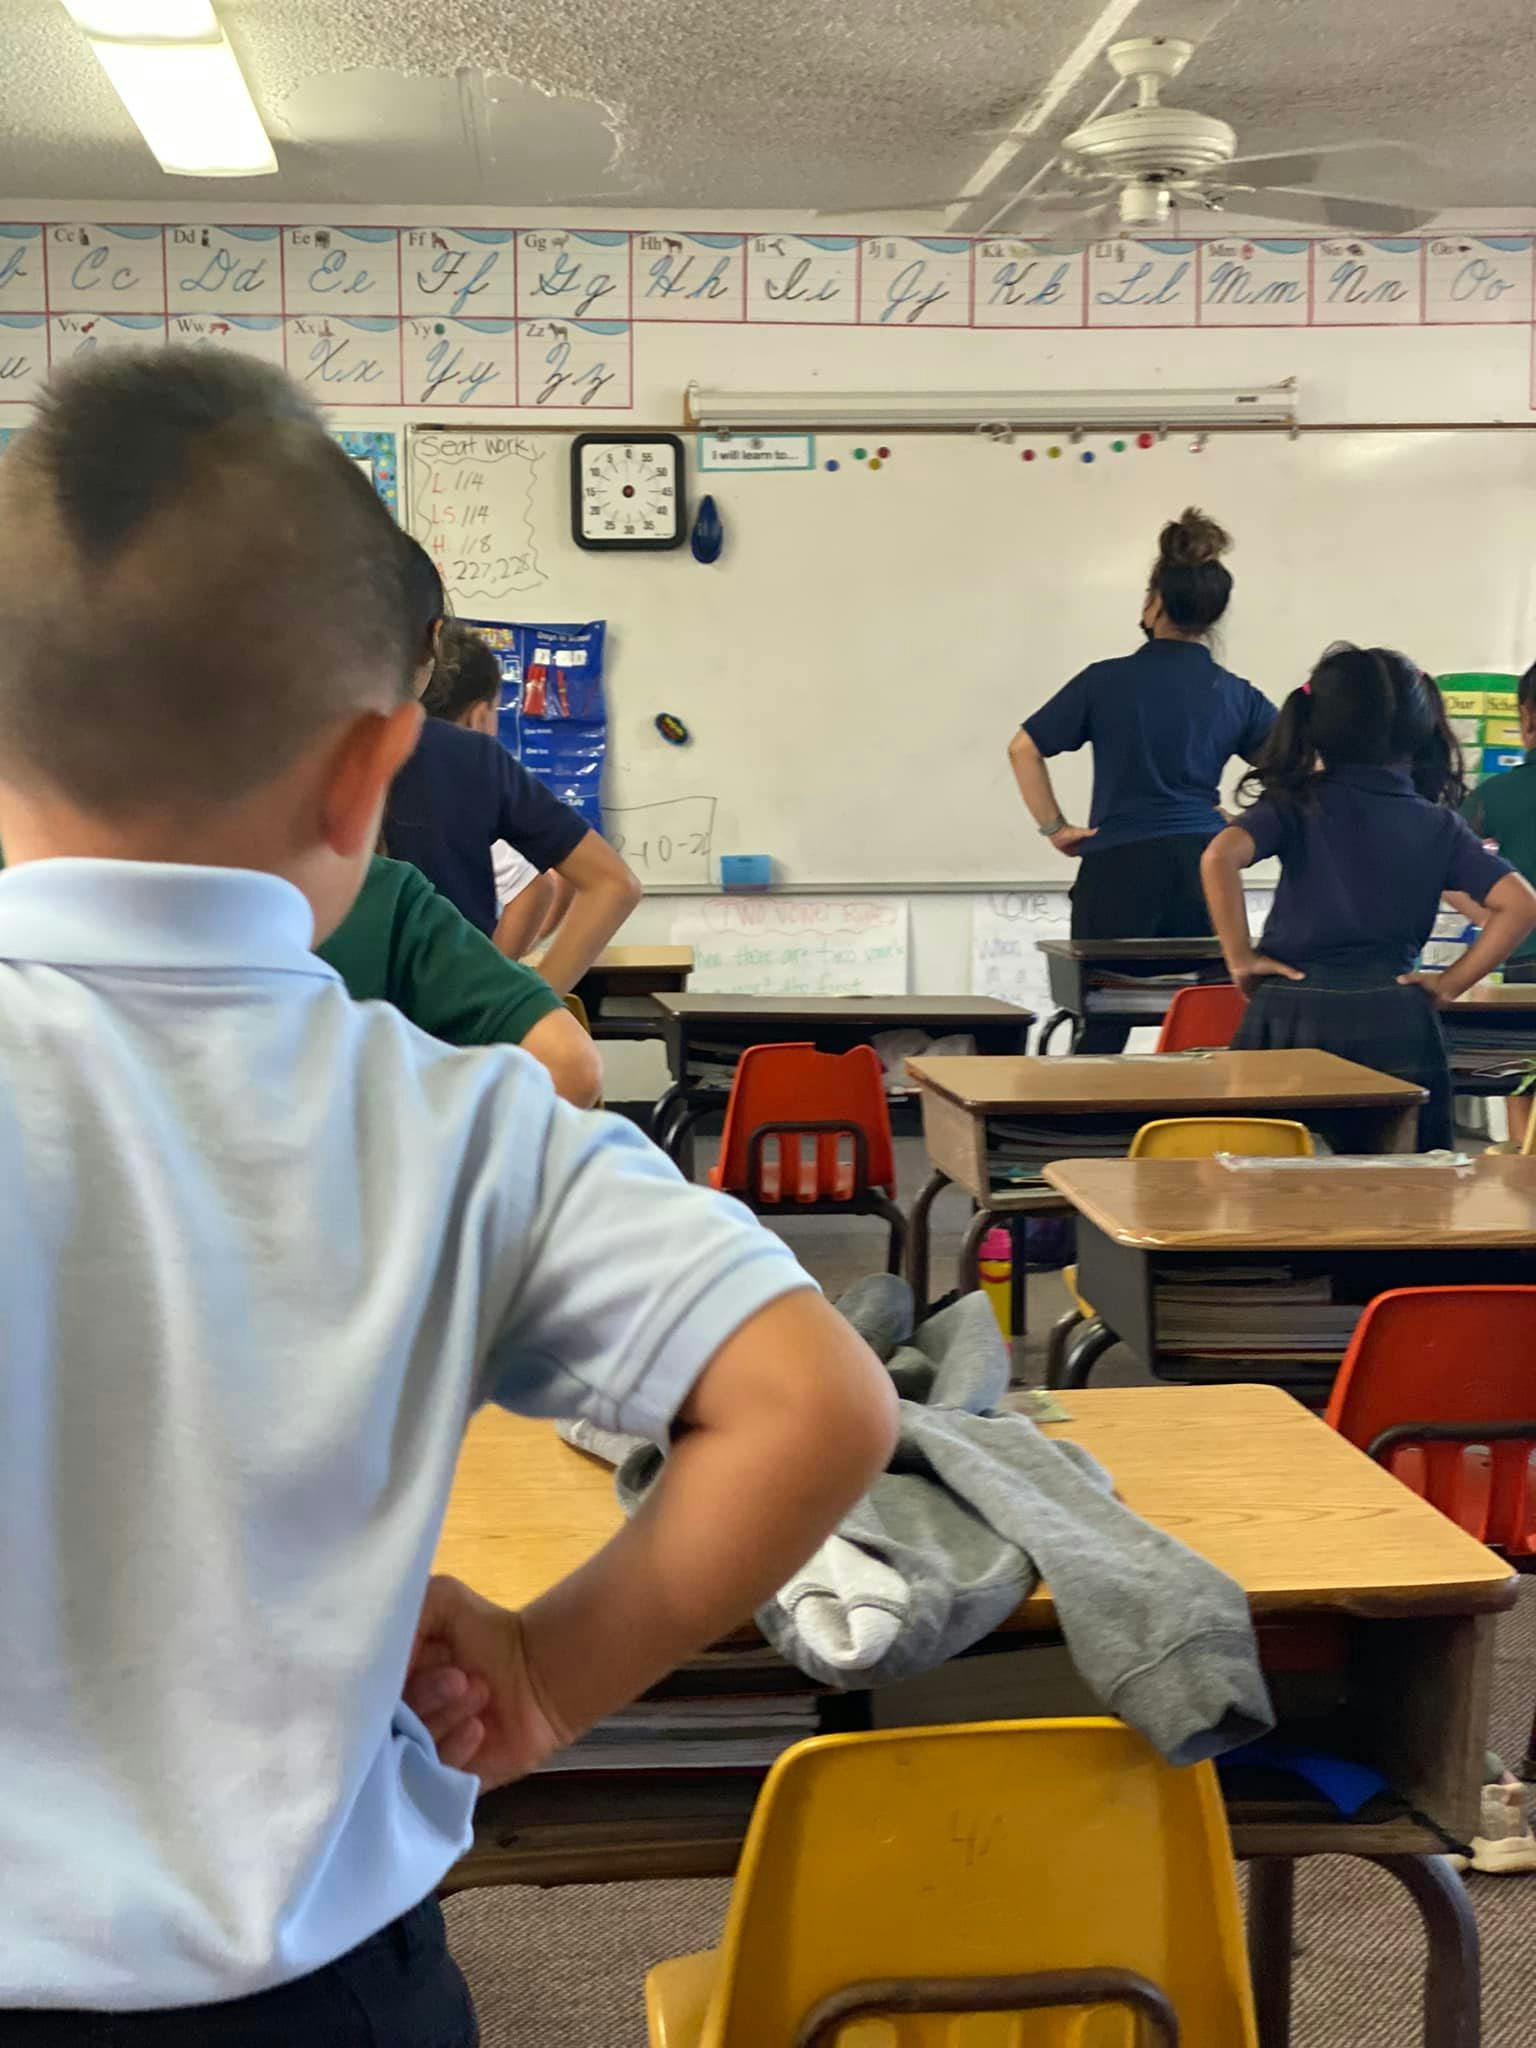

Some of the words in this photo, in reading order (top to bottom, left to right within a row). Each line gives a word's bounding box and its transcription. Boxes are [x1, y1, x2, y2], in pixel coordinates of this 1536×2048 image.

[54, 227, 76, 243] Cc
[173, 227, 196, 244] Dd
[408, 232, 425, 246] Ff
[524, 234, 547, 250] Gg
[420, 435, 477, 457] Seat
[485, 436, 529, 456] work
[719, 450, 740, 461] will
[742, 450, 773, 461] learn
